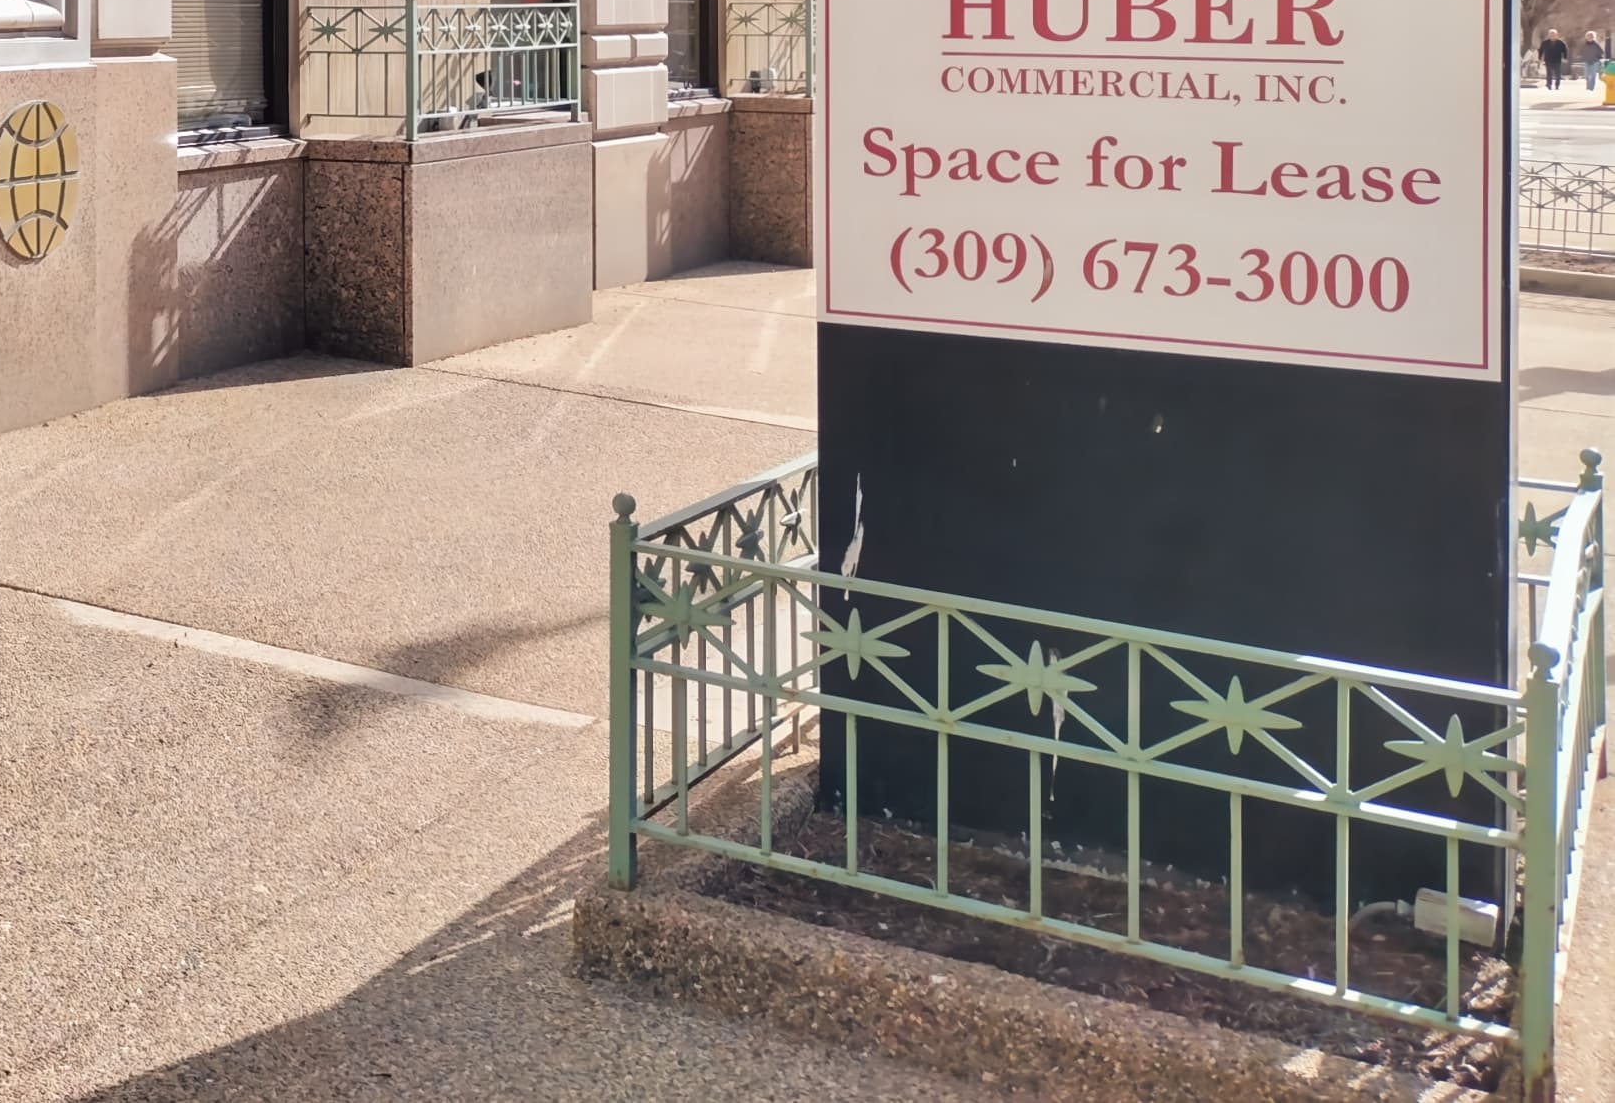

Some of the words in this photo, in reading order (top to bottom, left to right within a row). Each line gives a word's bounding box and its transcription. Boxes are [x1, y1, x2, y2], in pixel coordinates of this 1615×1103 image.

[940, 66, 1241, 107] COMMERCIAL,
[1255, 73, 1347, 105] INC.
[863, 127, 1059, 197] Space
[1086, 136, 1187, 192] for
[1212, 140, 1442, 205] Lease
[889, 227, 1055, 303] (309)
[1082, 238, 1411, 313] 673-3000
